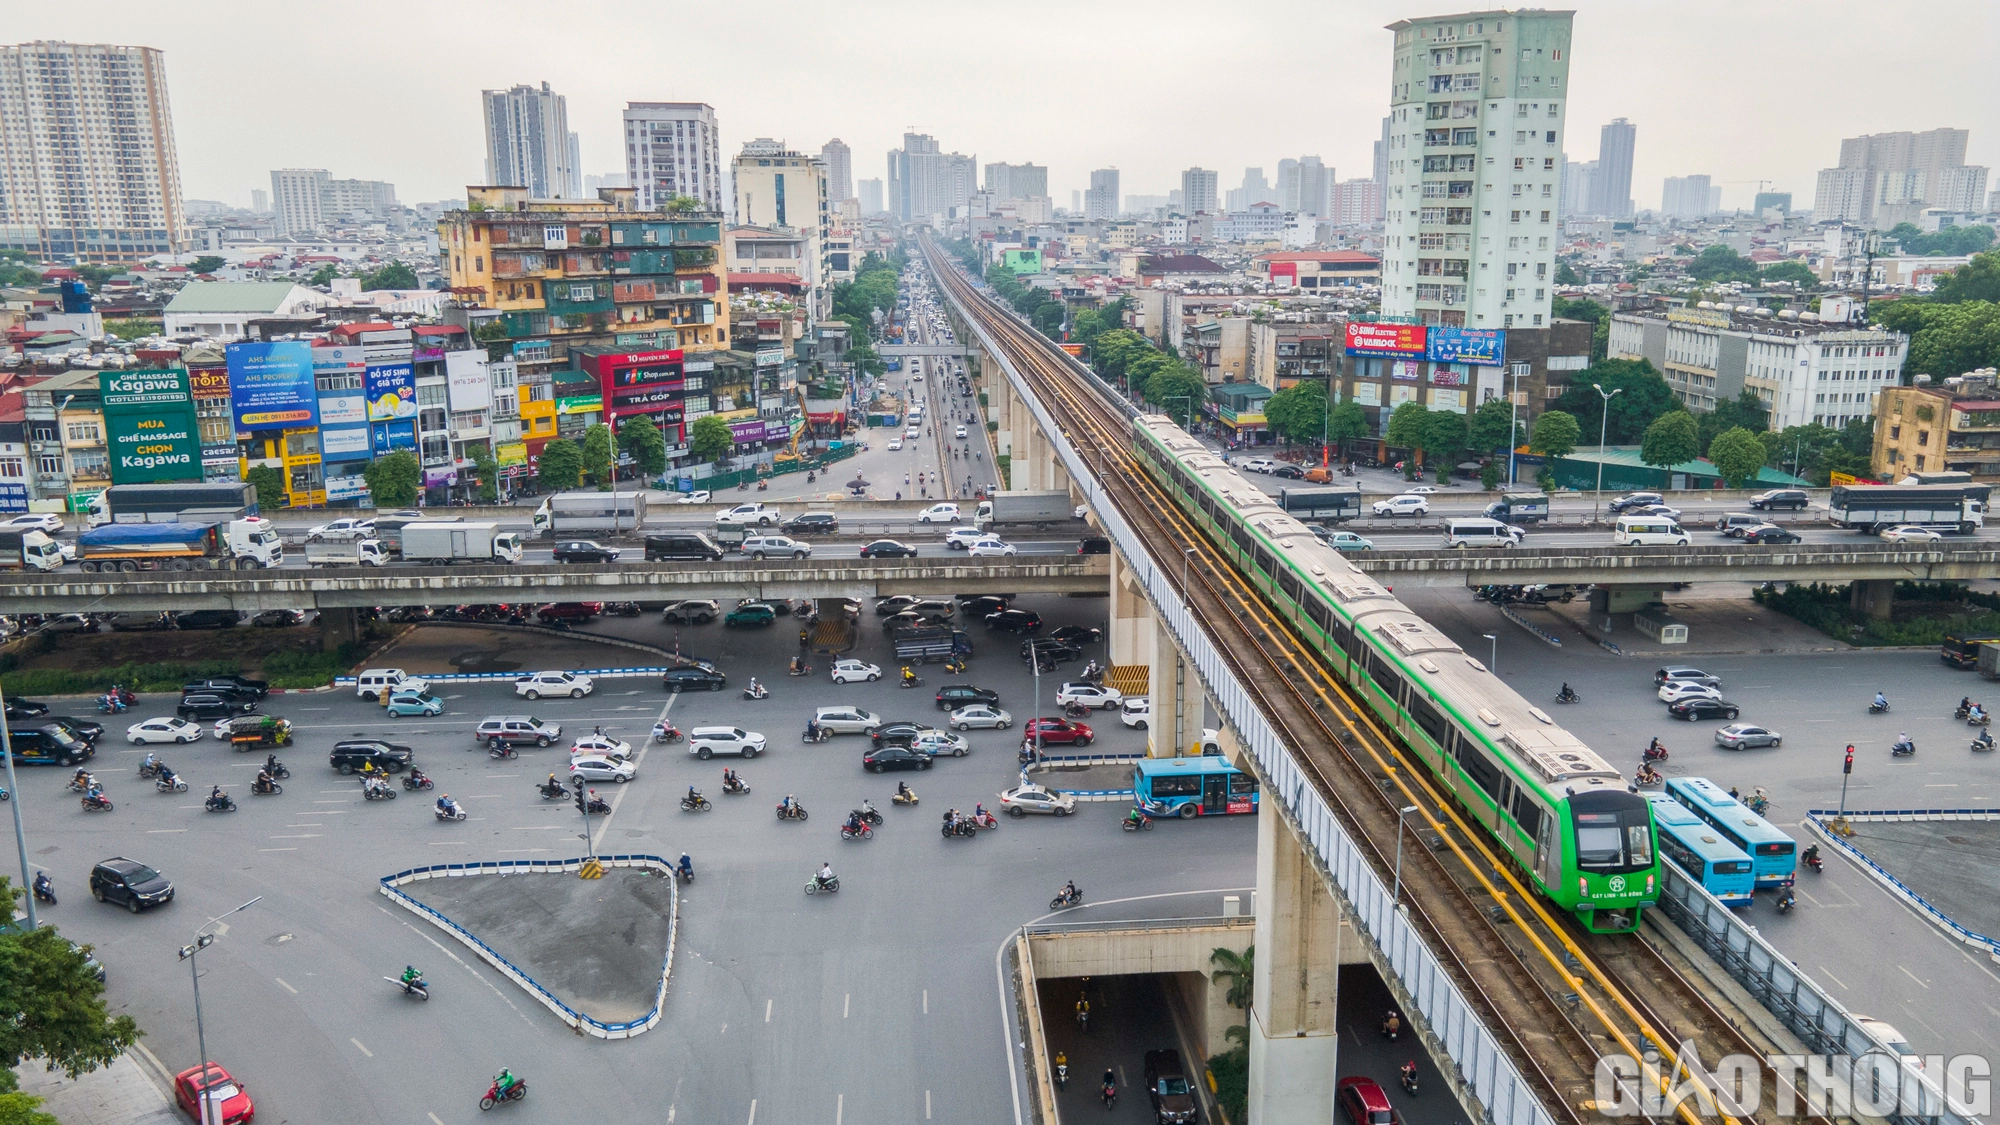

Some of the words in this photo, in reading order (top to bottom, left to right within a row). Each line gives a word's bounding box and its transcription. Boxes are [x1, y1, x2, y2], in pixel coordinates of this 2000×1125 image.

[393, 368, 410, 377] SINH
[110, 380, 179, 393] Kagawa
[629, 394, 648, 403] TRẢ
[651, 392, 669, 401] GÓP
[138, 420, 165, 429] MUA
[118, 433, 139, 442] GHẾ
[140, 432, 187, 441] MASSAGE
[136, 444, 173, 455] CHỌN
[122, 454, 190, 468] Kagawa
[9, 486, 24, 495] THUÊ
